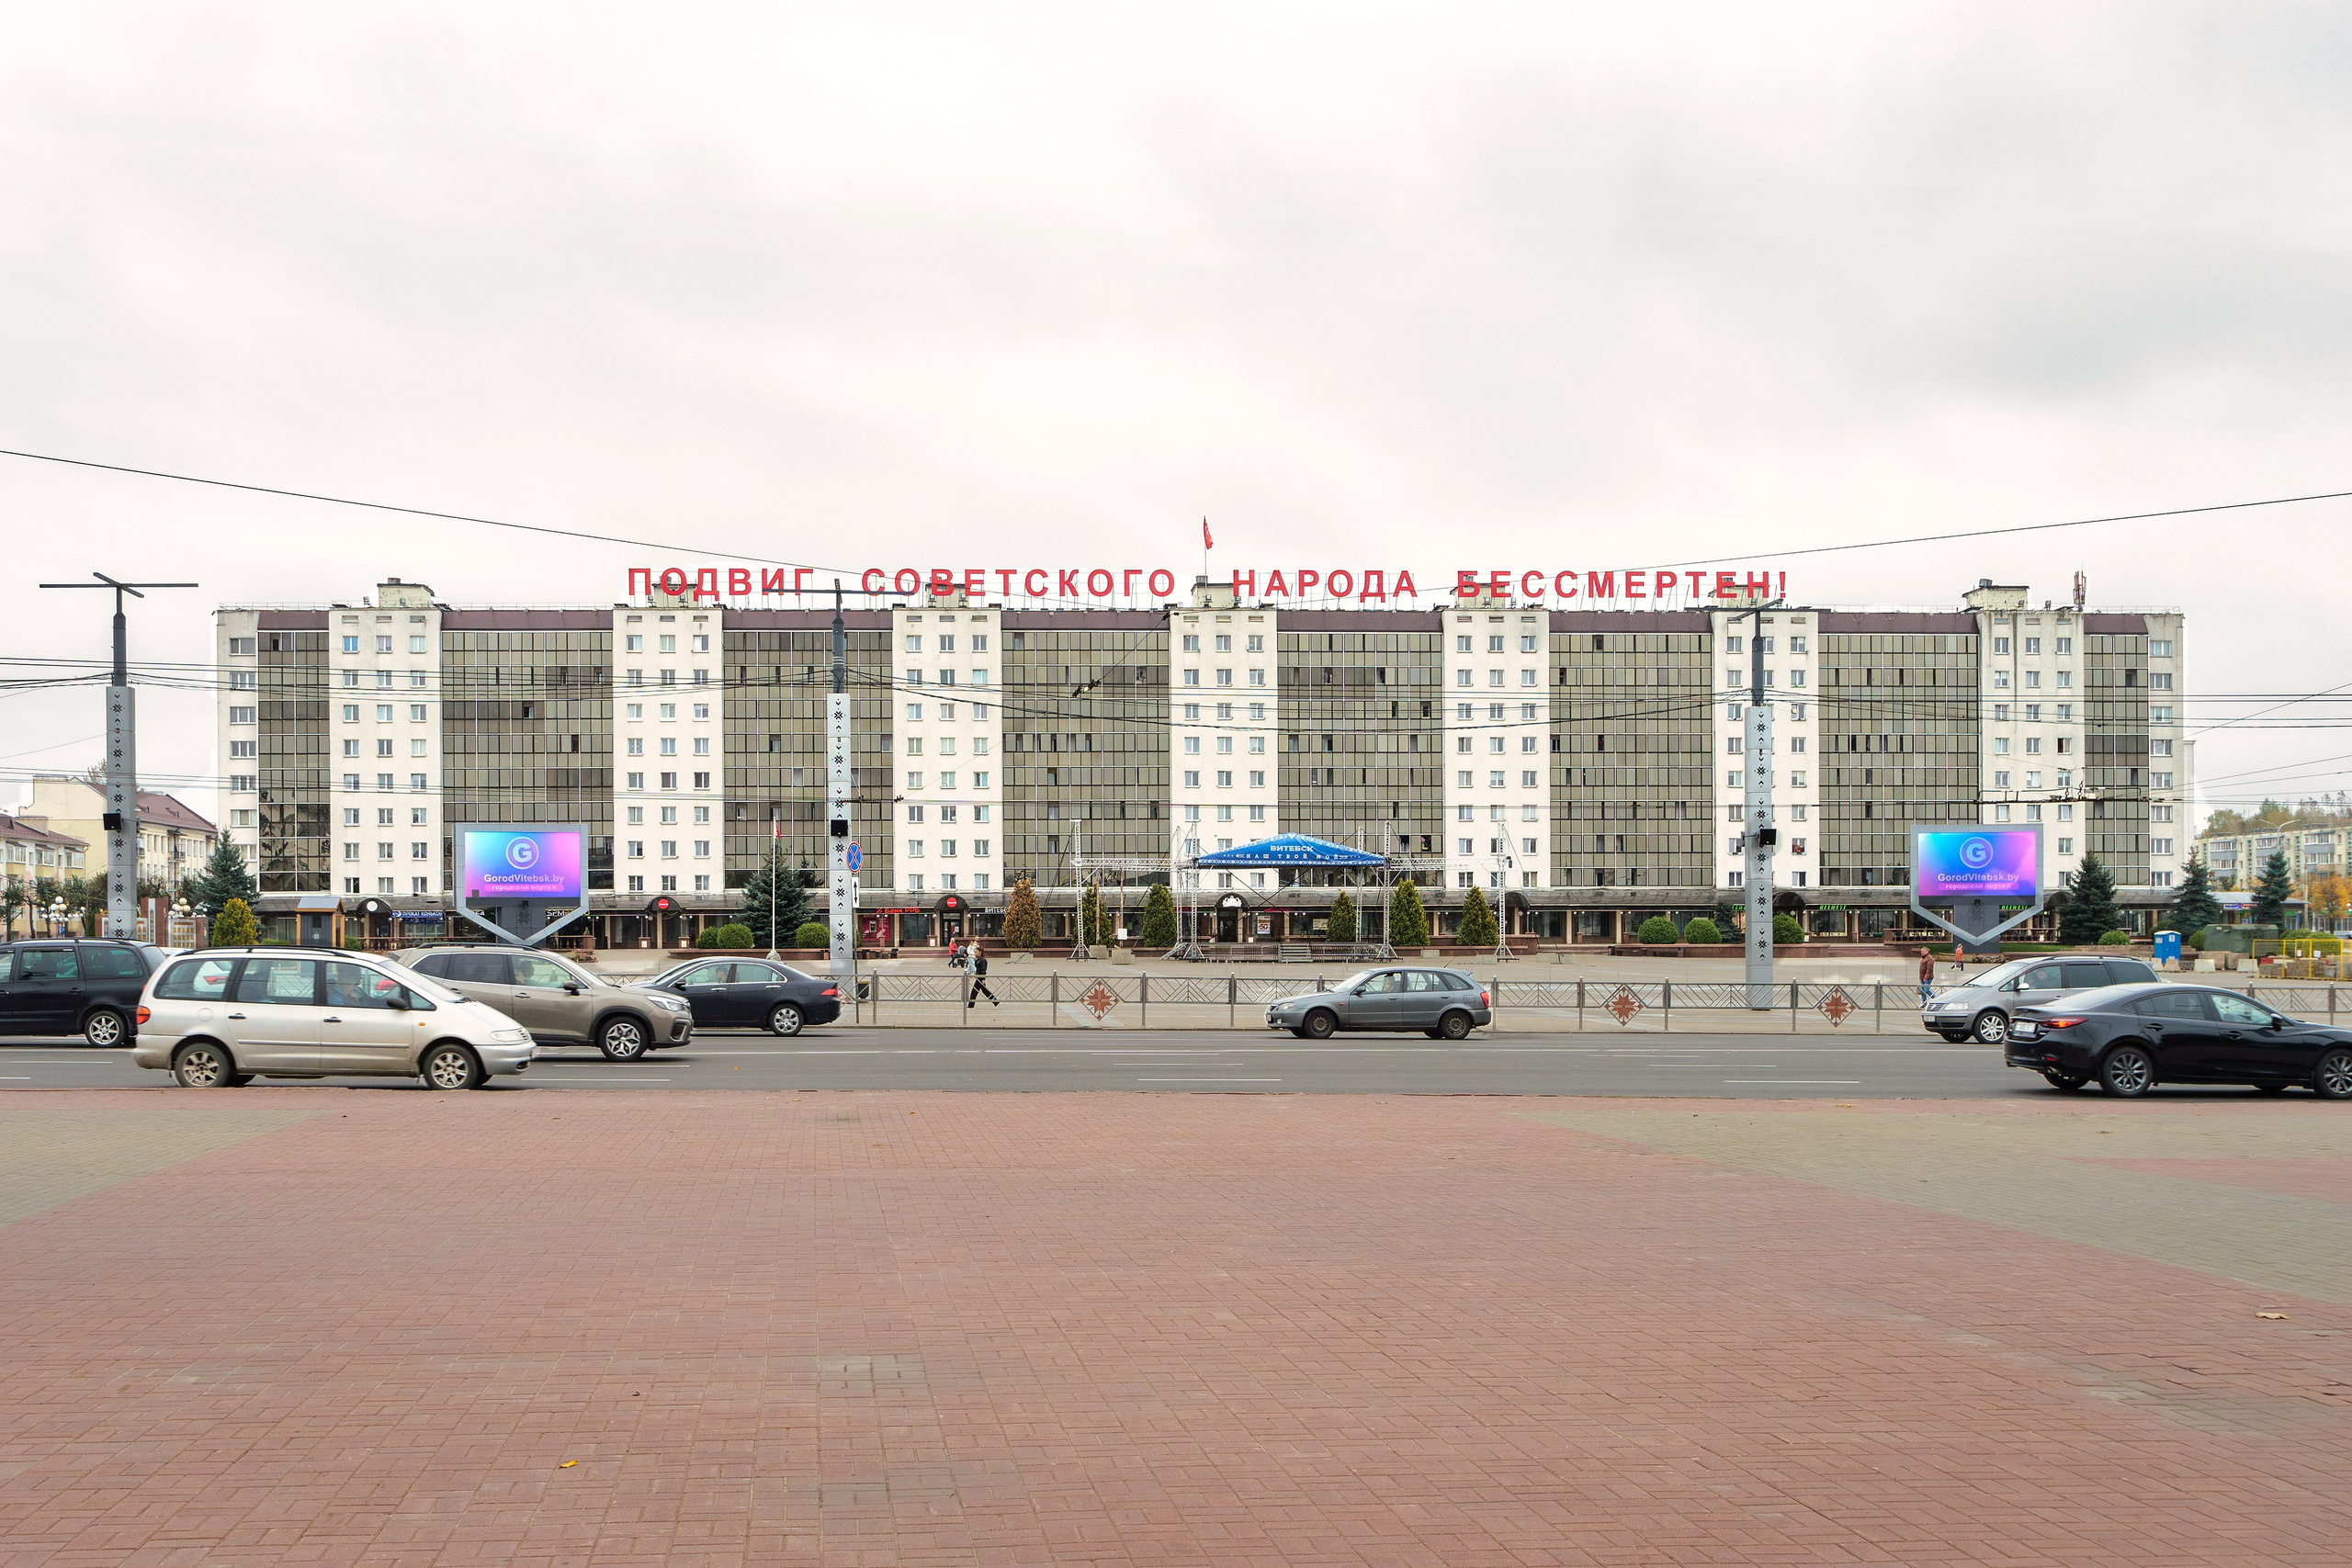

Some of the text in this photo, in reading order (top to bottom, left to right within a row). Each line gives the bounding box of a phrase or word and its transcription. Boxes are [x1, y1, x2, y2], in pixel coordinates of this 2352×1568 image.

[628, 568, 1786, 604] ПОДВИГ СОВЕТСКОГО НАРОДА БЕССМЕРТЕН!
[513, 843, 532, 863] G
[1966, 843, 1986, 862] G
[483, 874, 564, 885] GorodVitebsk.by
[1938, 873, 2019, 883] GorodVitebsk.by
[1945, 883, 1983, 891] городской
